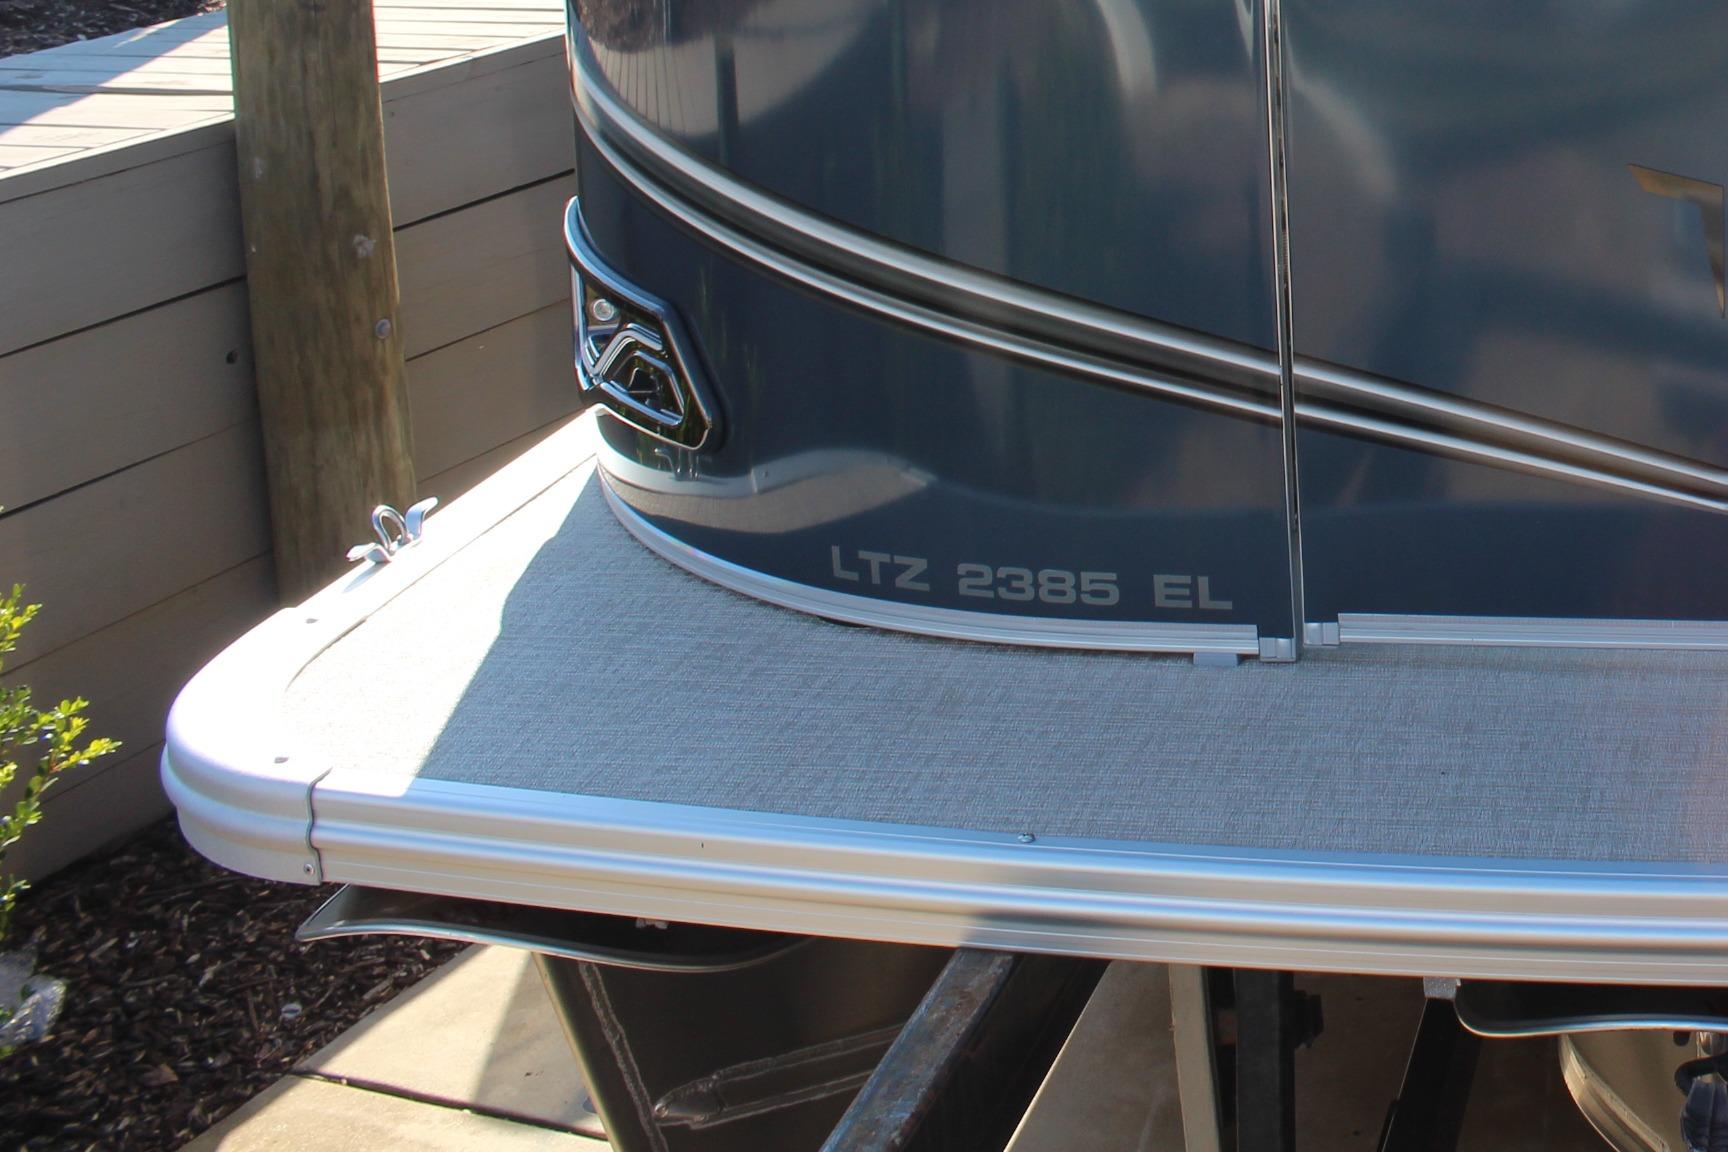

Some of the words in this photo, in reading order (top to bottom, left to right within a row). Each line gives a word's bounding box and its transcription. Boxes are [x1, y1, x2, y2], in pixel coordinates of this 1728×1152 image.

[832, 545, 930, 592] LTZ
[957, 562, 1120, 606] 2385
[1153, 574, 1233, 610] EL
